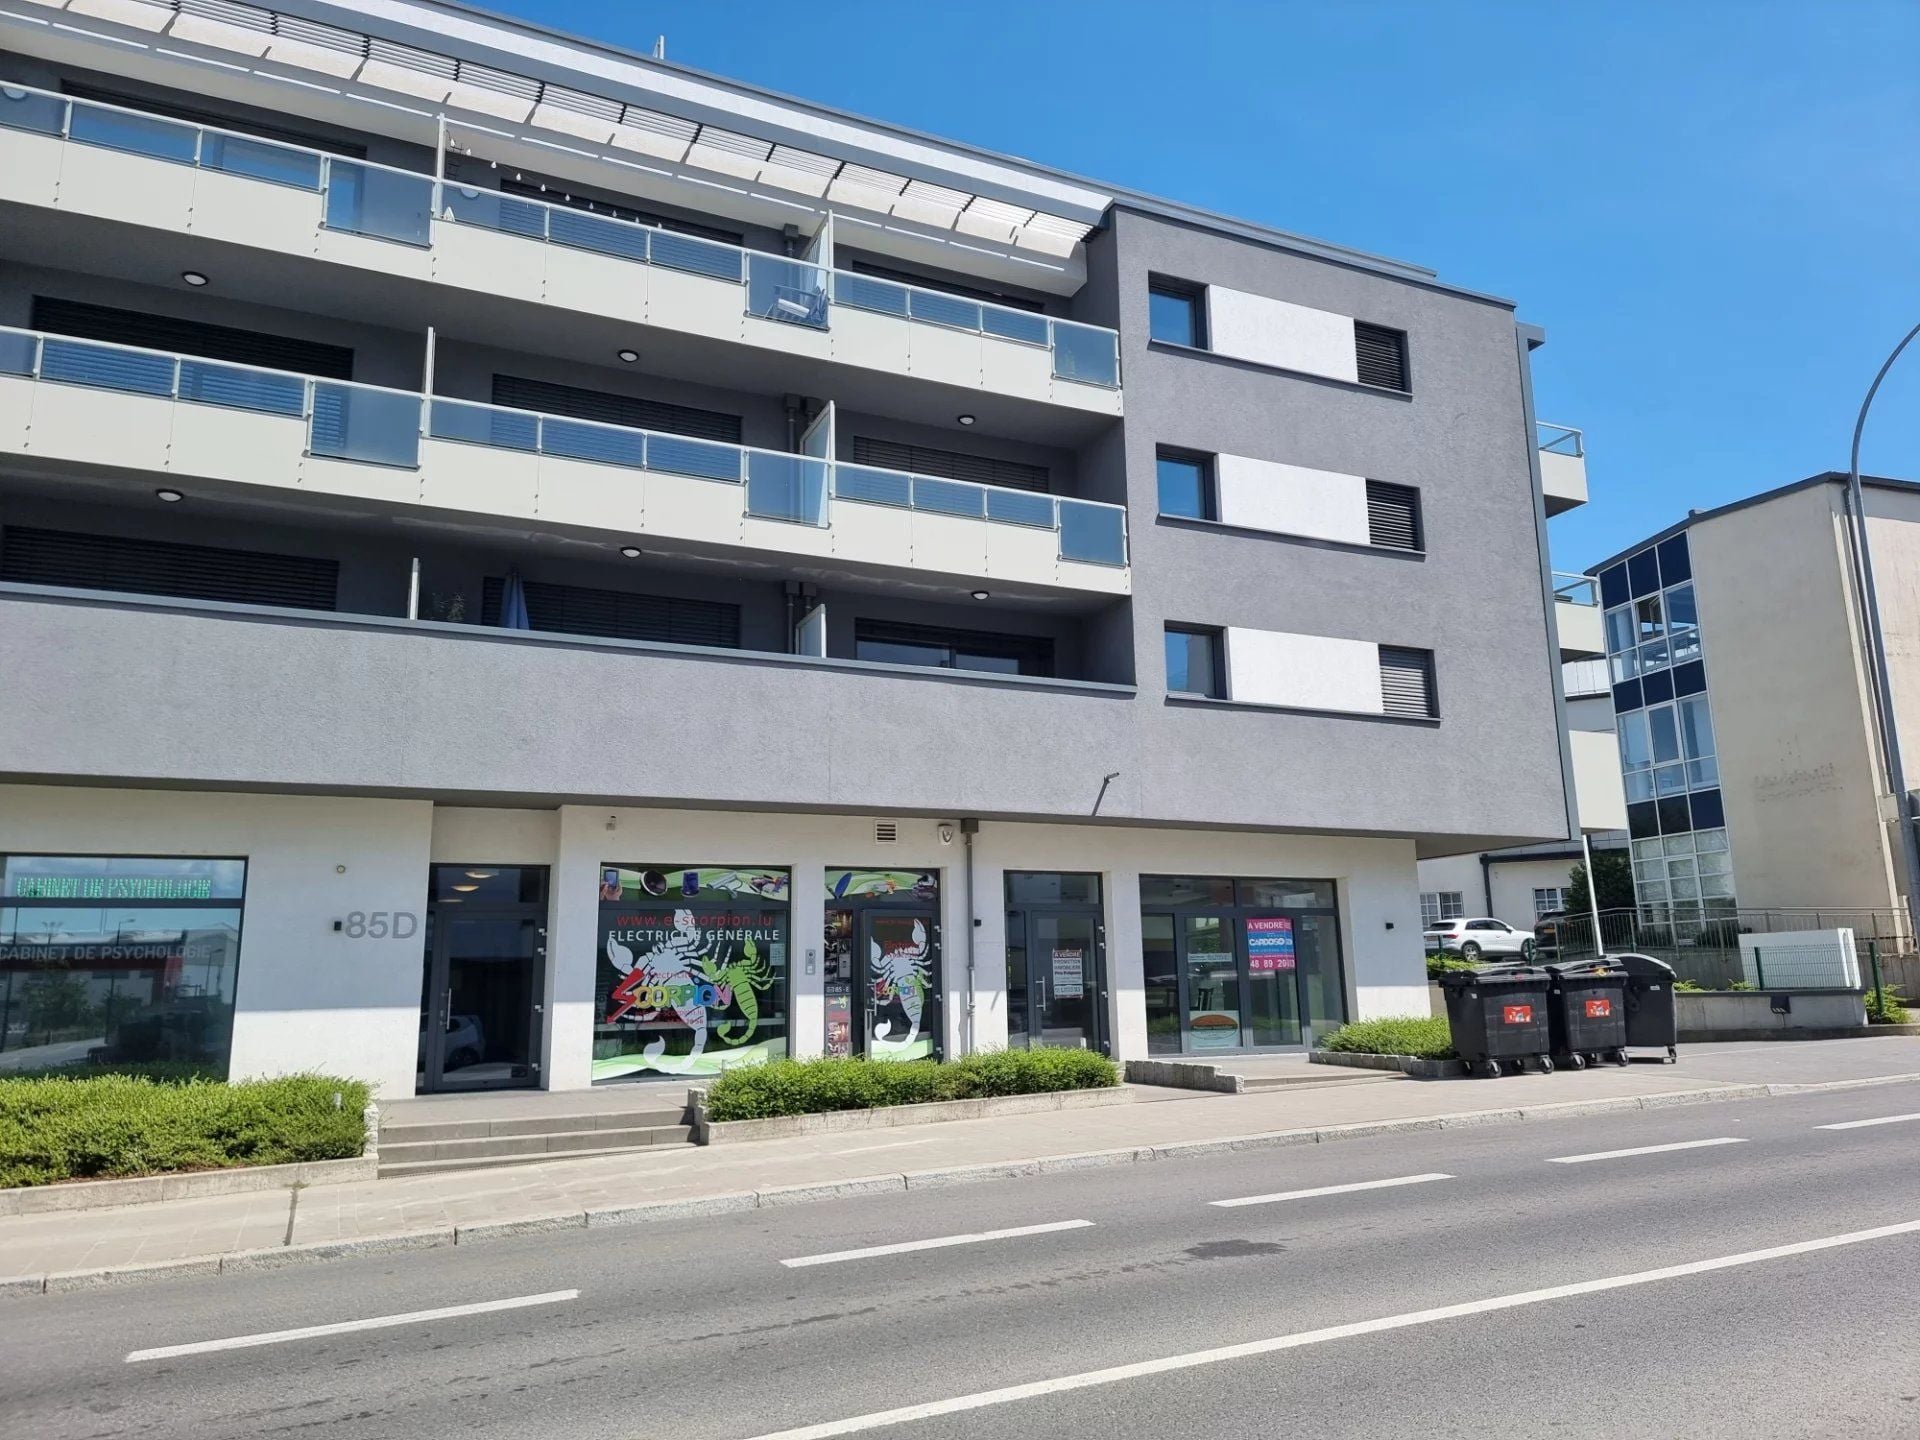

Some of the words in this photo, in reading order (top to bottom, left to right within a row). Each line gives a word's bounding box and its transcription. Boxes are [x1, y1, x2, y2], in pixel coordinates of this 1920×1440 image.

[345, 911, 418, 939] 85D
[616, 912, 774, 930] www.e-scorpion.lu
[1254, 921, 1284, 930] VENDRE
[706, 927, 780, 942] GÉNÉRALE
[1249, 938, 1285, 946] CARDOSO
[0, 945, 70, 960] CABINET
[74, 945, 97, 960] DE
[101, 945, 212, 960] PSYCHOLOGIE
